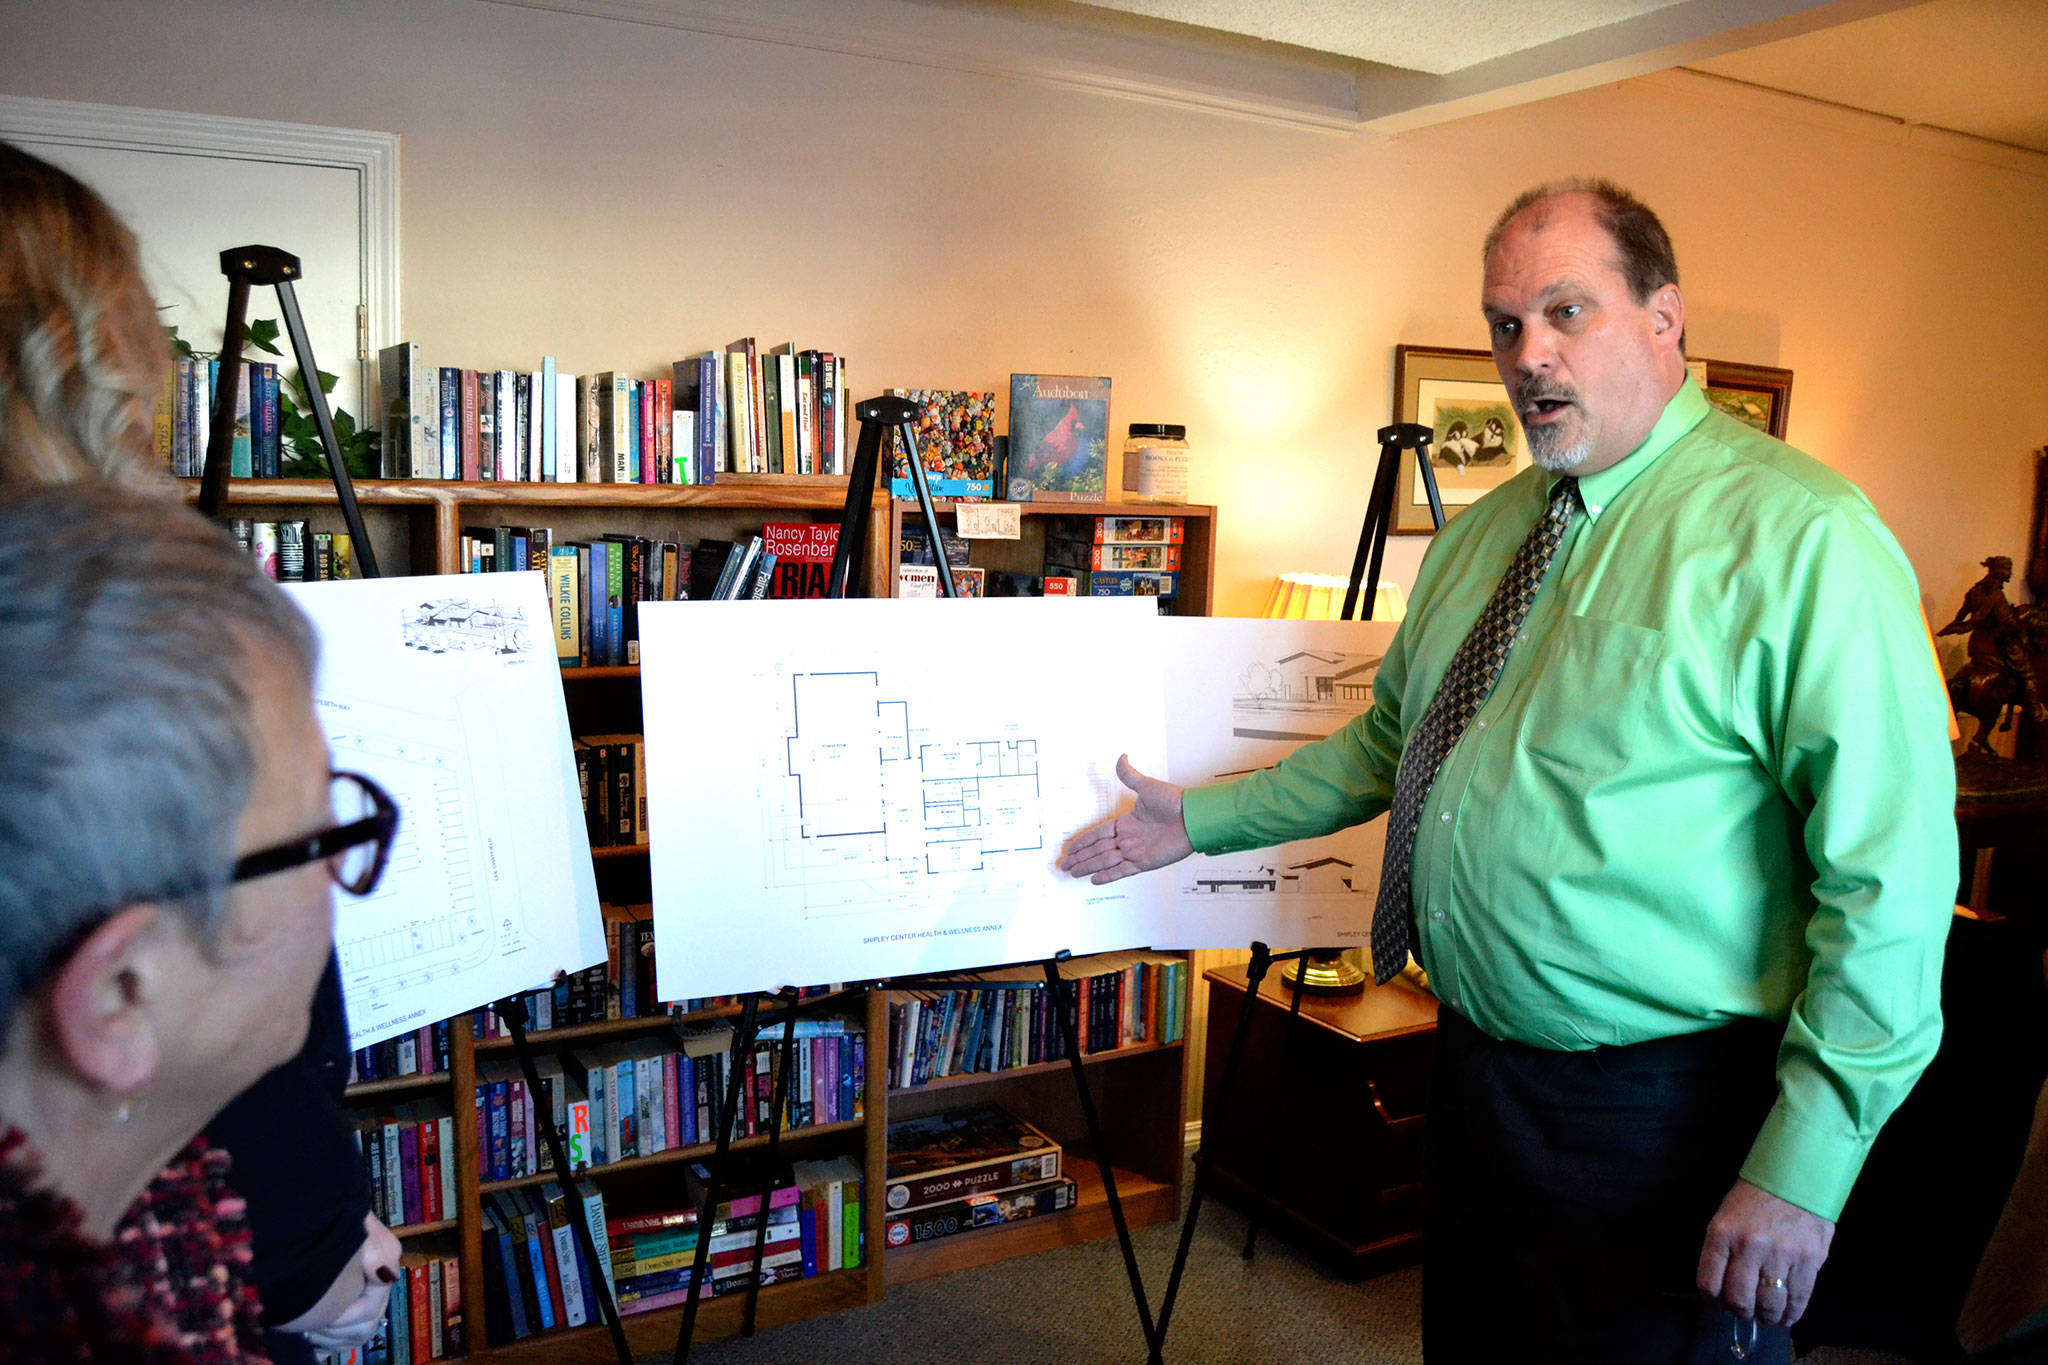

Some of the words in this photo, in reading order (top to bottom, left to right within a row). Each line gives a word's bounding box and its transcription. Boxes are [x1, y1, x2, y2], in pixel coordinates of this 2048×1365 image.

[617, 377, 626, 392] THE
[825, 372, 833, 389] WIEHL
[1032, 384, 1088, 399] Audubon
[617, 453, 625, 472] MAN
[966, 483, 982, 491] 750
[1070, 492, 1103, 502] Puzzle
[766, 526, 805, 542] Nancy
[809, 526, 840, 542] Taylo
[765, 539, 834, 557] Rosenber
[320, 554, 328, 567] GOD
[559, 574, 571, 604] WILKIE
[752, 571, 771, 599] Fairste
[769, 562, 835, 597] TRIA
[1049, 582, 1064, 590] 550
[560, 606, 572, 640] COLLINS
[863, 935, 889, 944] SHIPLEY
[890, 933, 917, 941] CENTER
[917, 930, 942, 938] HEALTH
[948, 926, 981, 935] WELLNESS
[982, 924, 1002, 932] ANNEX
[351, 1029, 370, 1039] EALTH
[376, 1016, 407, 1031] WELLNESS
[408, 1009, 426, 1019] ANNEX
[573, 1105, 589, 1133] R
[570, 1134, 582, 1162] S
[923, 1182, 950, 1195] 2000
[964, 1171, 999, 1186] PUZZLE
[591, 1203, 604, 1242] DANIELLE
[914, 1216, 958, 1240] 1500
[597, 1243, 608, 1265] STEEL
